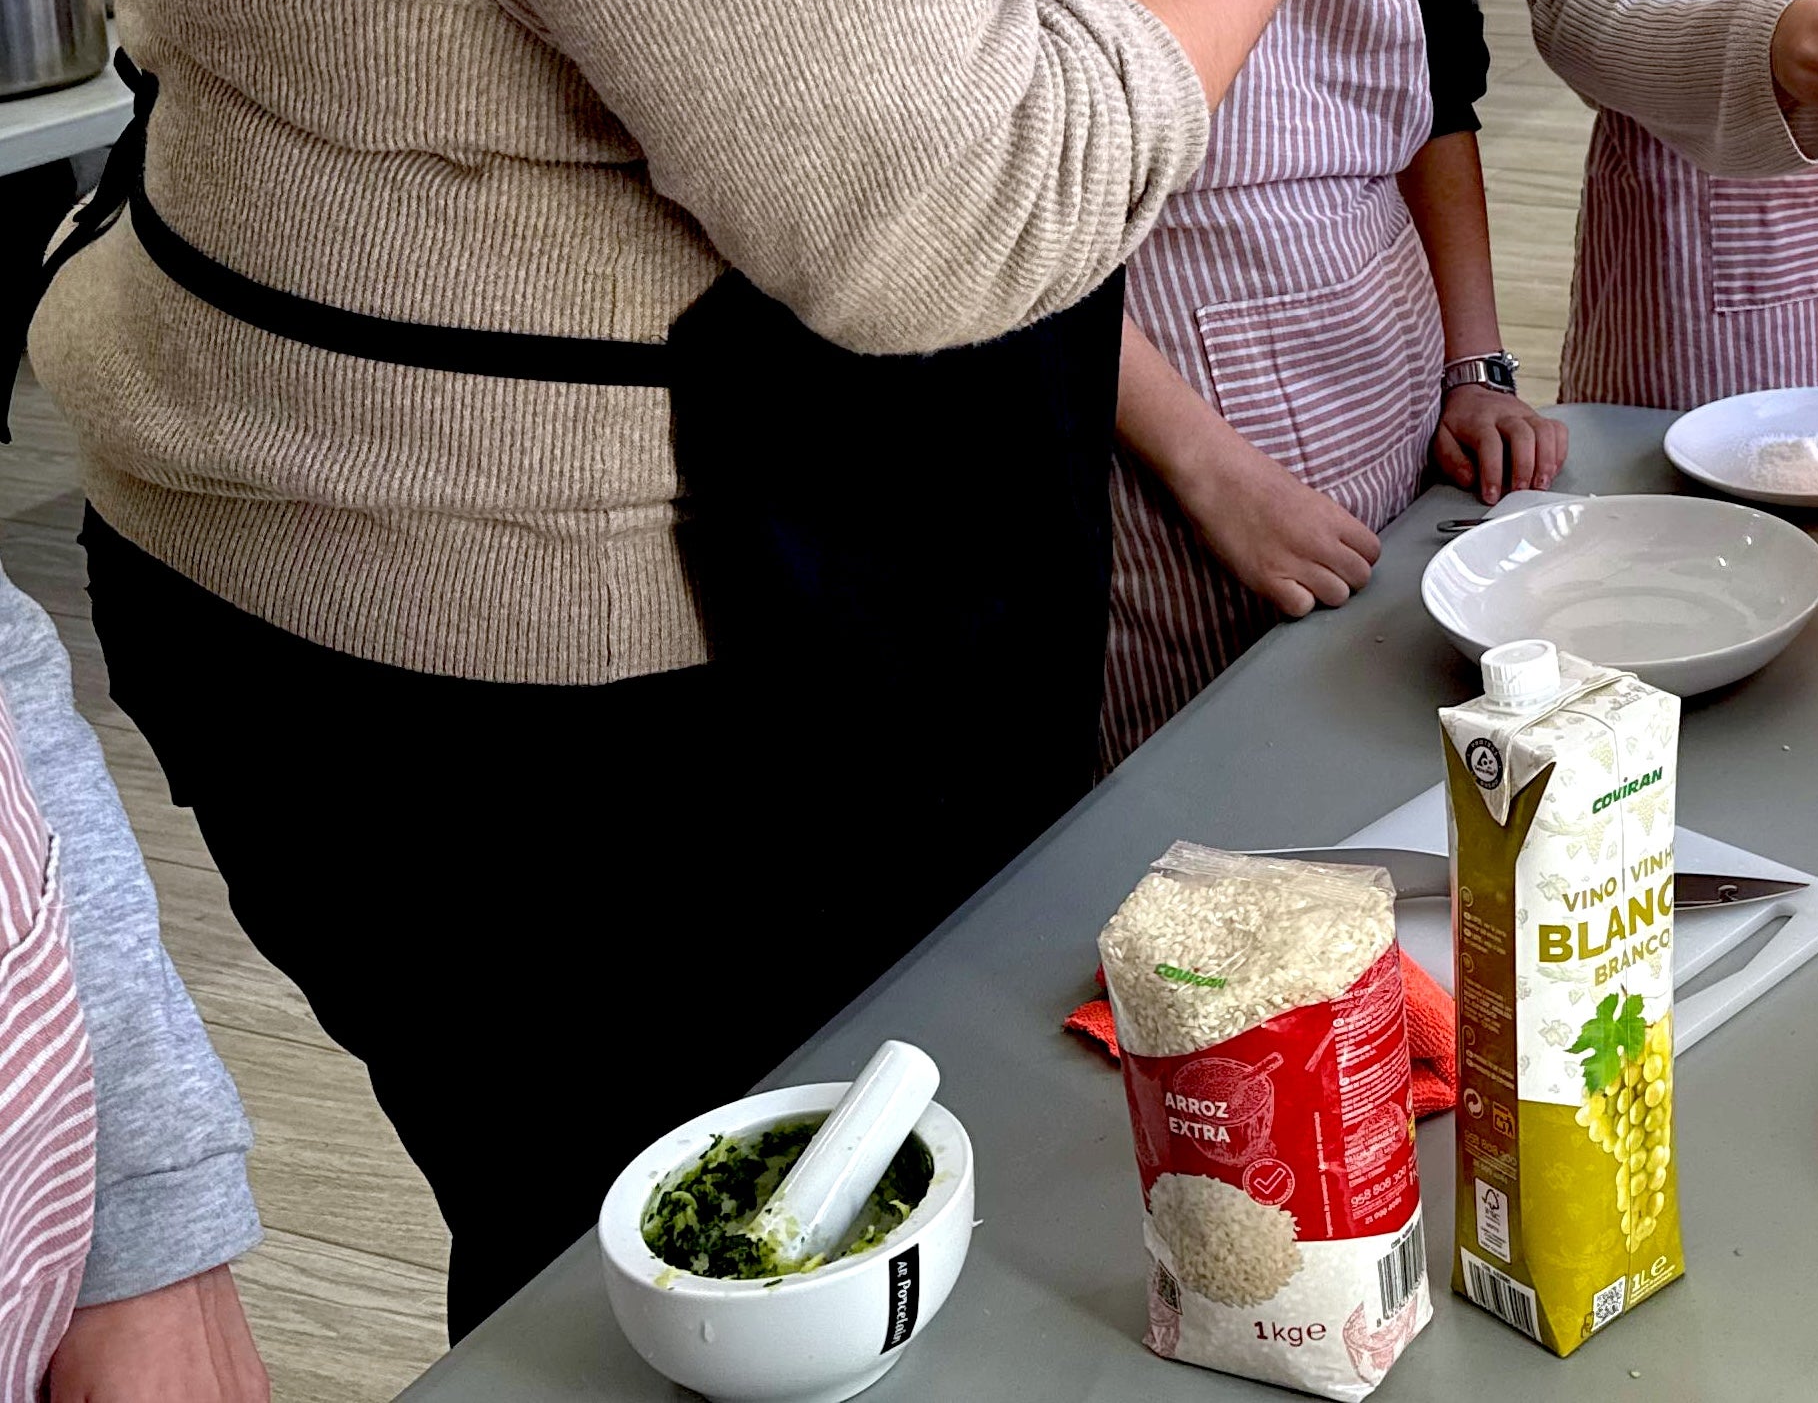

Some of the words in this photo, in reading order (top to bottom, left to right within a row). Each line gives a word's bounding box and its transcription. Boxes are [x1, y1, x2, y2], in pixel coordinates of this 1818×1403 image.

[1591, 766, 1664, 815] COVIRAN
[1562, 877, 1618, 913] VINO
[1630, 842, 1675, 883] VINH
[1594, 927, 1671, 987] BRANCO
[1165, 1092, 1230, 1118] ARROZ
[1168, 1116, 1231, 1143] EXTRA
